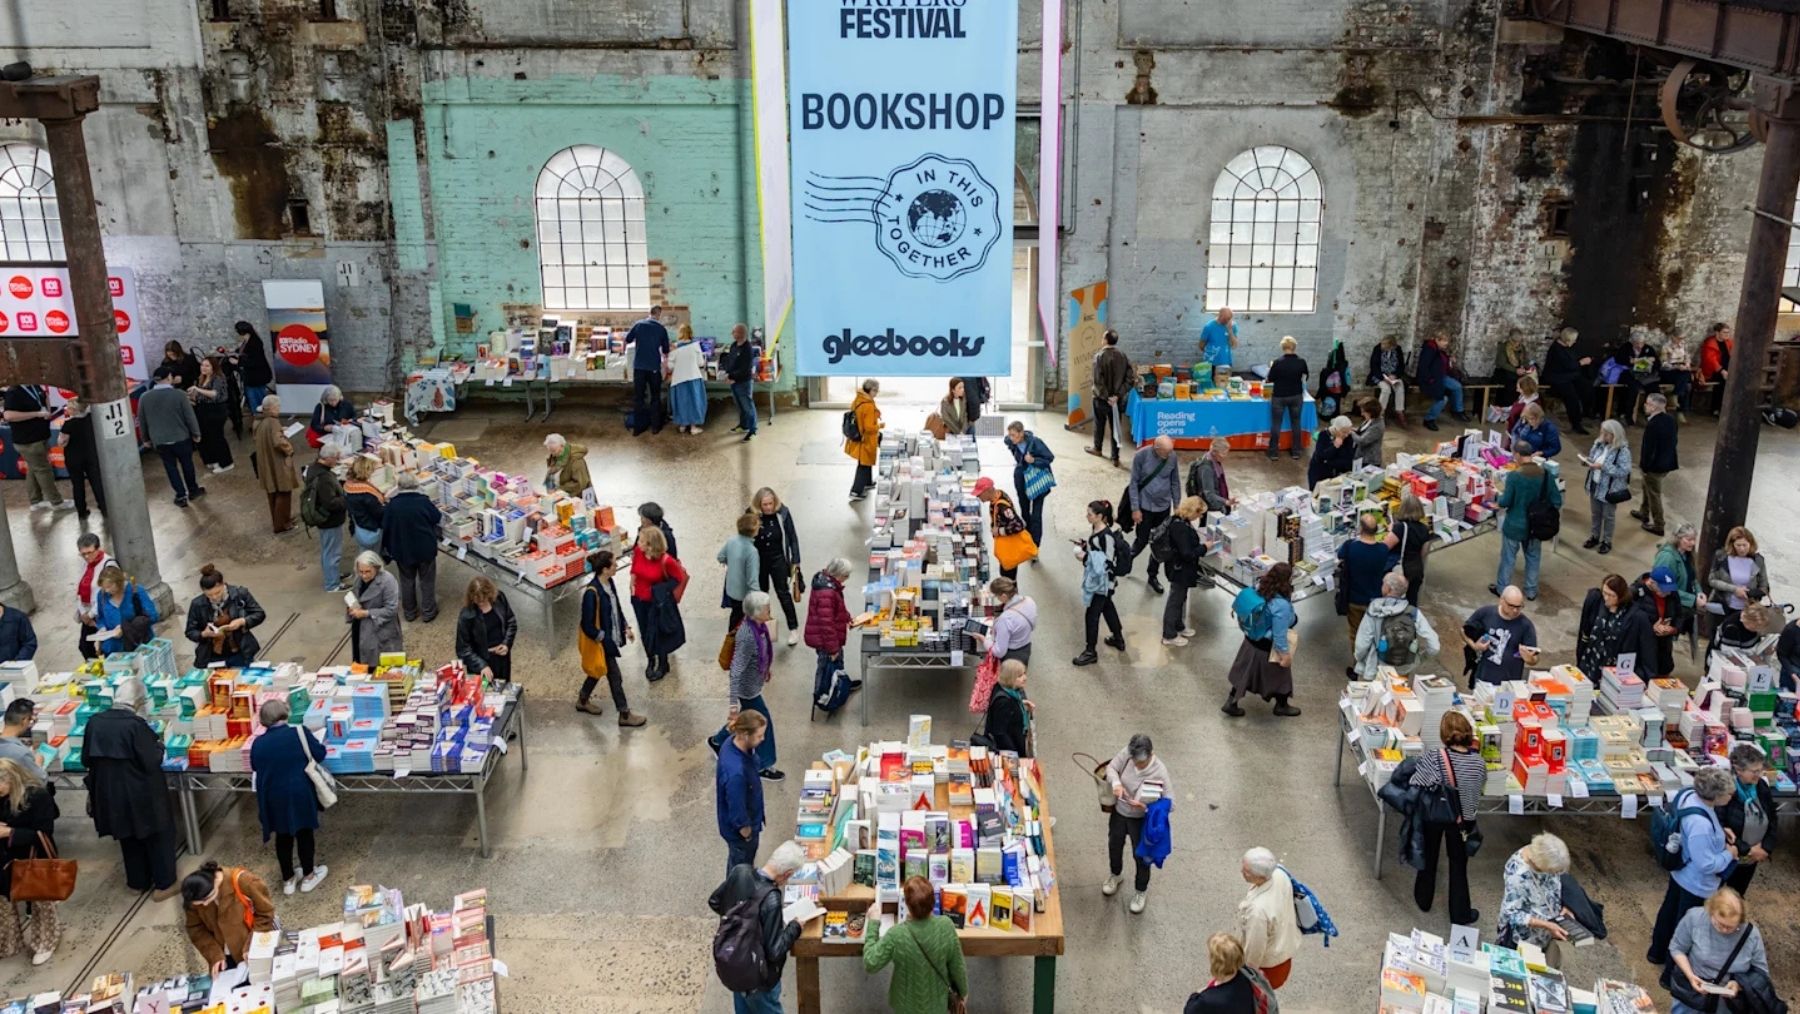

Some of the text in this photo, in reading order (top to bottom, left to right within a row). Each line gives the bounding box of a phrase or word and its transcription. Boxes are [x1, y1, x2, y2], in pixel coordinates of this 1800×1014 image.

[840, 8, 967, 39] FESTIVAL
[802, 92, 1005, 130] BOOKSHOP
[916, 169, 983, 208] IN THIS
[887, 215, 972, 269] TOGETHER
[280, 343, 318, 353] SYDNEY
[822, 328, 985, 364] gleebooks
[105, 402, 123, 420] J1
[1157, 411, 1195, 422] Reading
[114, 420, 125, 435] 2
[1157, 420, 1186, 428] opens
[1157, 427, 1184, 435] doors
[1620, 658, 1631, 669] G
[1756, 672, 1767, 684] E
[1500, 698, 1509, 709] D
[1455, 935, 1470, 948] A
[148, 1000, 160, 1013] Y
